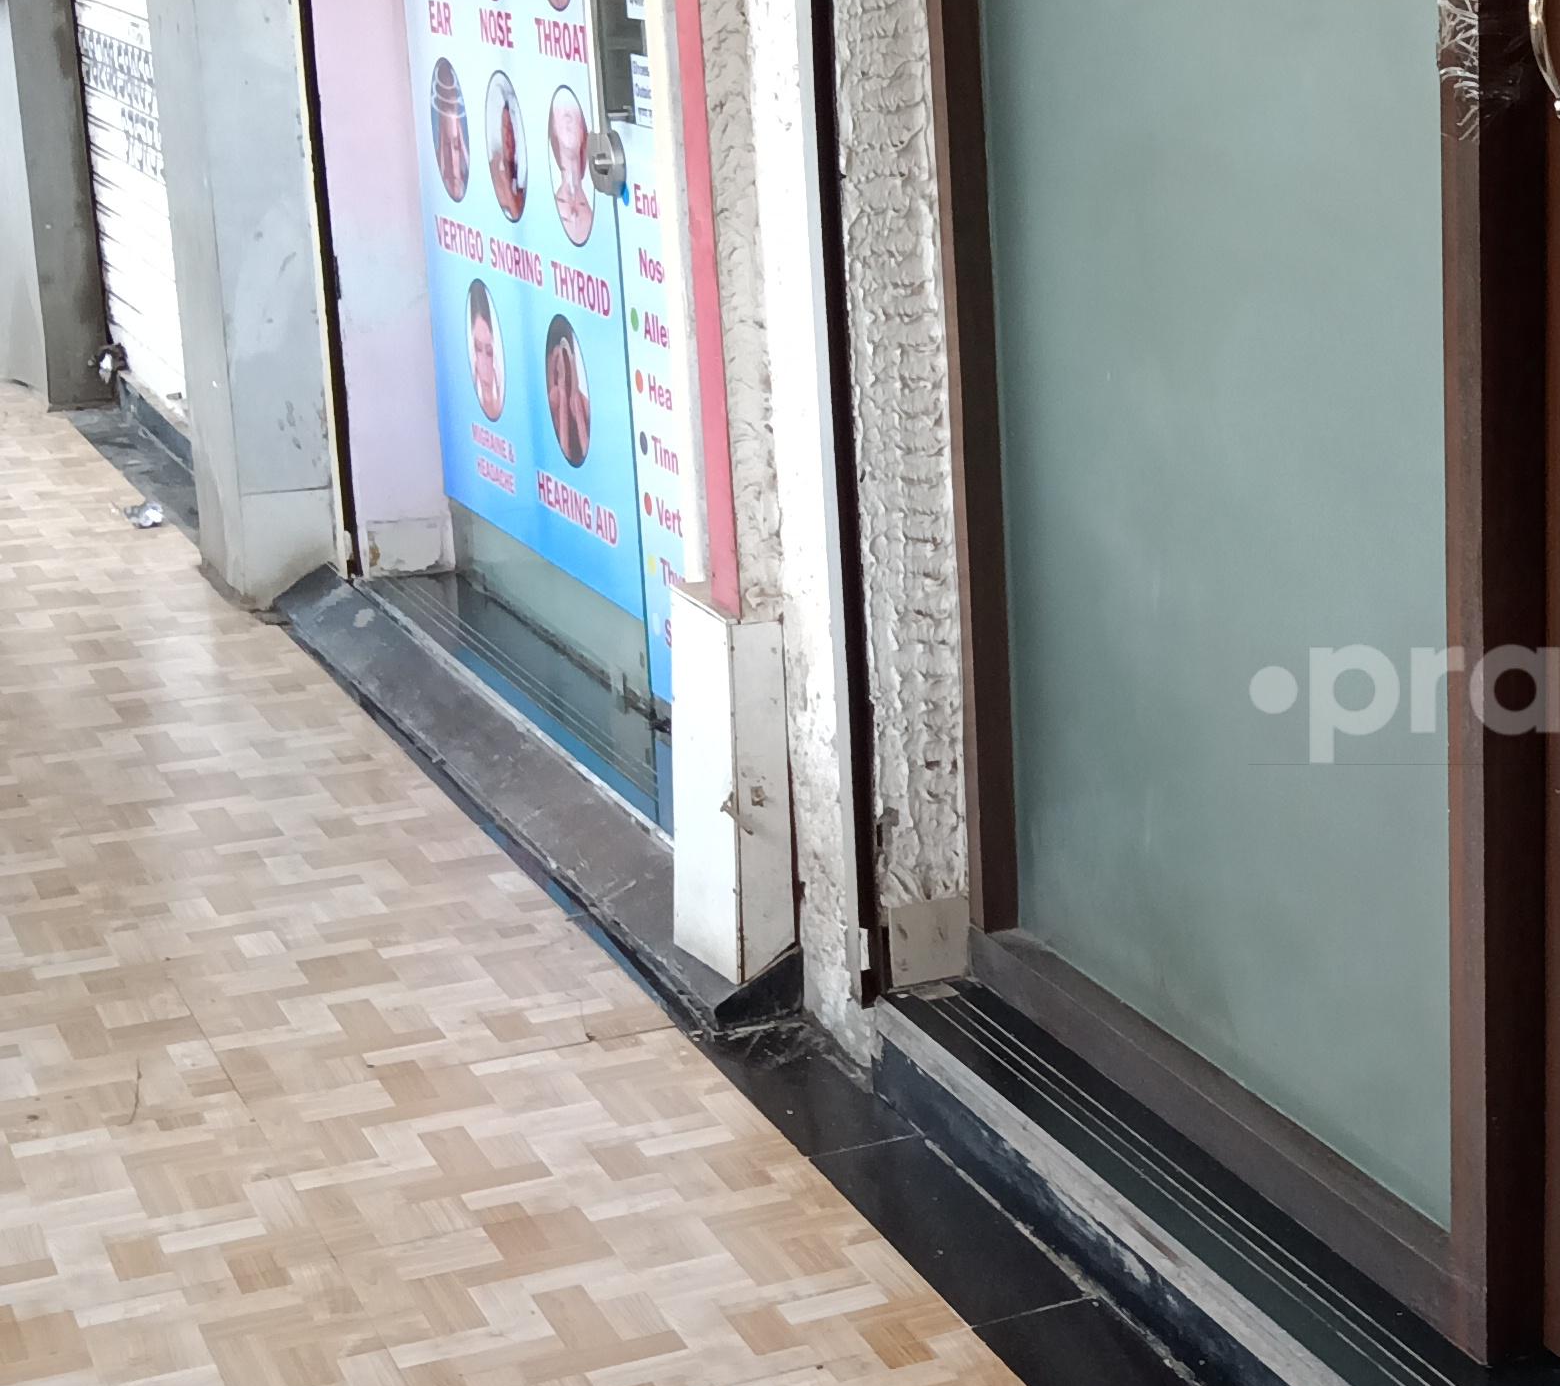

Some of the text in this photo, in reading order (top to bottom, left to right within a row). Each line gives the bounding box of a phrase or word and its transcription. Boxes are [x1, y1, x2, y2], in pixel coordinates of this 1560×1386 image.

[428, 0, 588, 64] EAR NOSE THROAT
[434, 215, 611, 316] VERTIGO SNORING THYROID
[536, 469, 618, 545] HEARING AID
[656, 496, 683, 538] Vert
